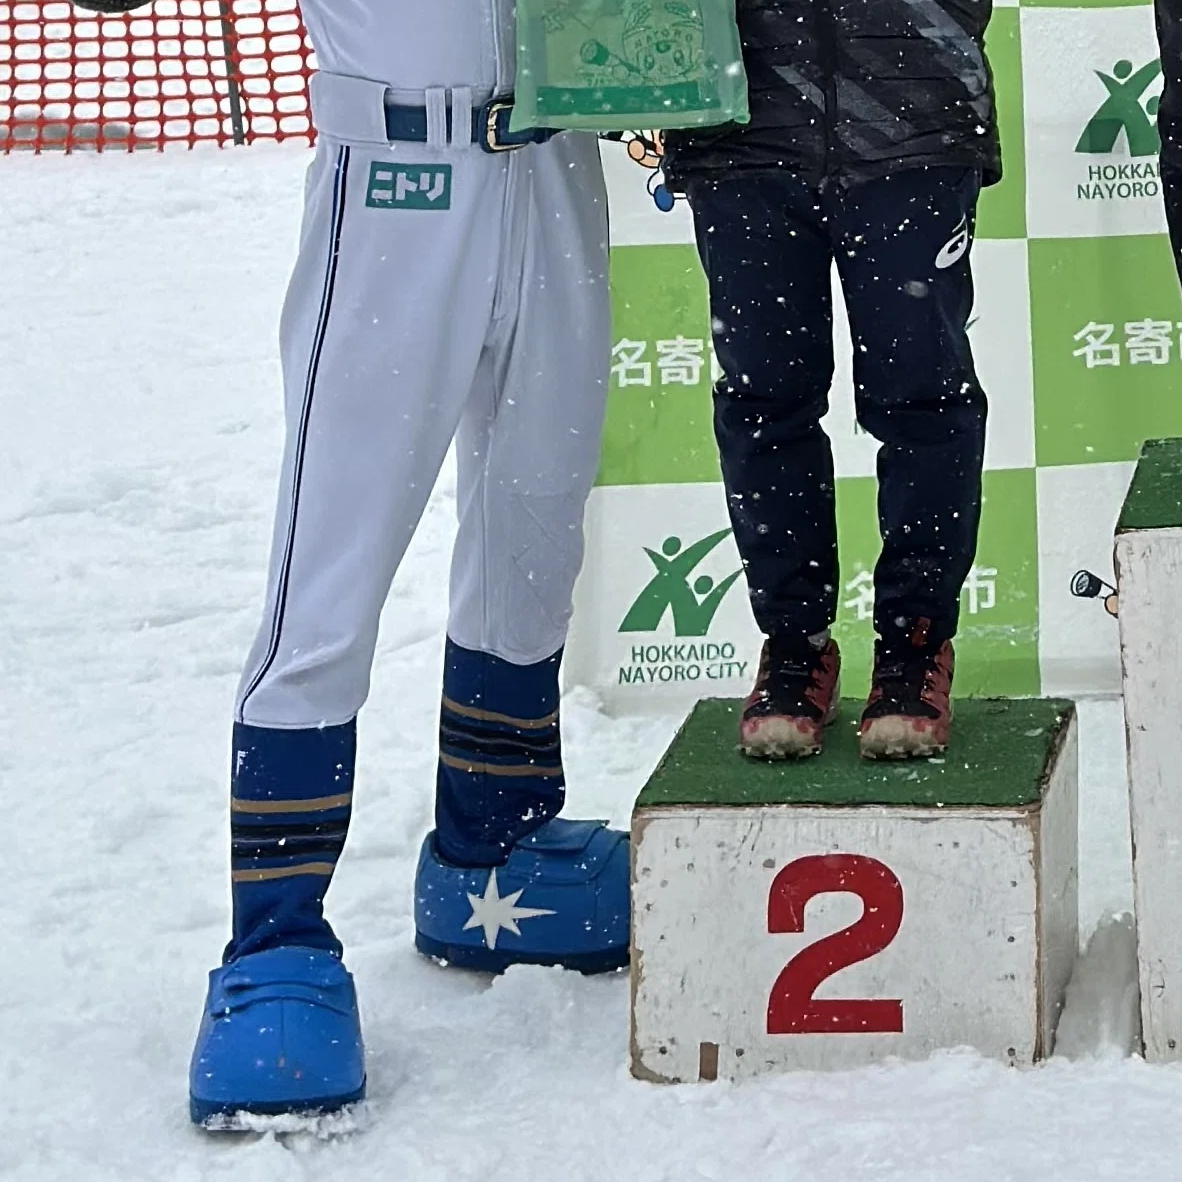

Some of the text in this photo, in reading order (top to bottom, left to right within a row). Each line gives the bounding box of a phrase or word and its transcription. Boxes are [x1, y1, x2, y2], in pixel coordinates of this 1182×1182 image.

[1088, 163, 1160, 181] HOKKAI
[371, 171, 445, 201] ニトリ
[1077, 181, 1158, 200] NAYORO
[611, 335, 714, 387] 名寄
[845, 567, 997, 620] 名市
[631, 642, 735, 662] HOKKAIDO
[619, 661, 748, 684] NAYORO CITY
[765, 853, 905, 1034] 2
